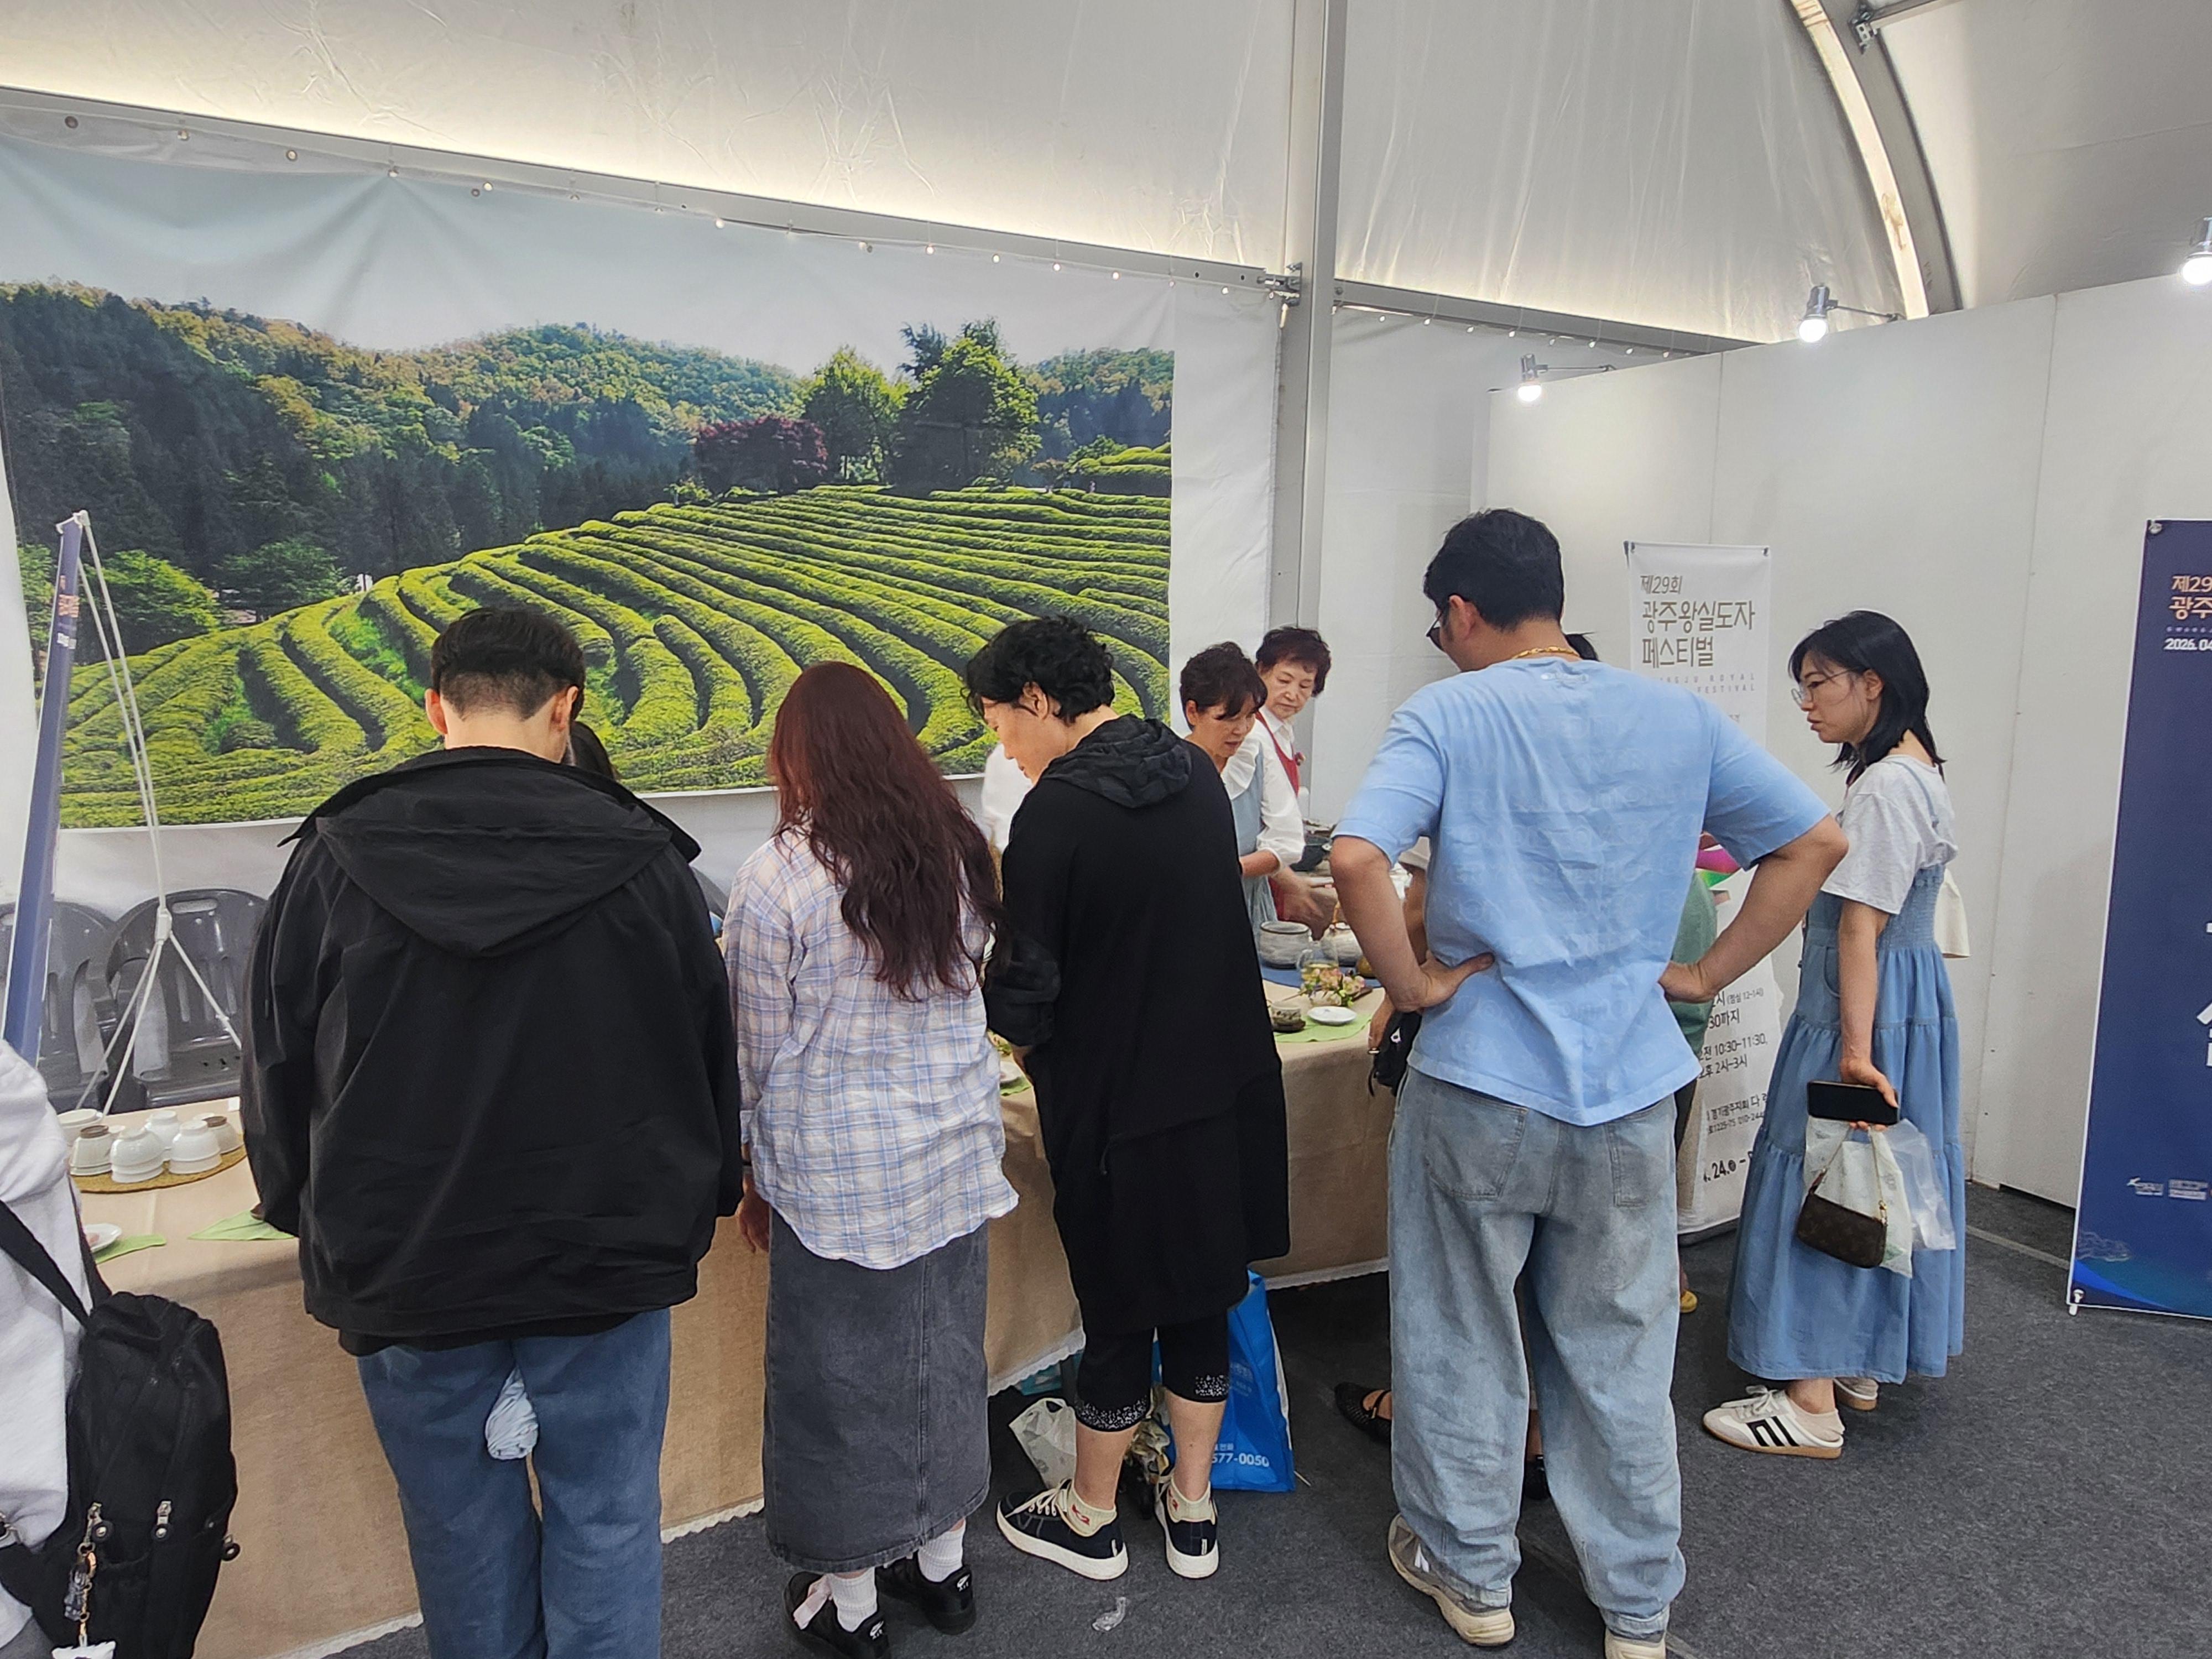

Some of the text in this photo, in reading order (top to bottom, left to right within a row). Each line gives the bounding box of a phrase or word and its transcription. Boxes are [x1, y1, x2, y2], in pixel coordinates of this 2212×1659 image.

[1640, 575, 1683, 594] 제29회
[1642, 601, 1755, 634] 광주왕실도자
[2169, 596, 2212, 620] 광주
[1642, 637, 1713, 668] 페스티벌
[1715, 1053, 1747, 1074] 2시-3시
